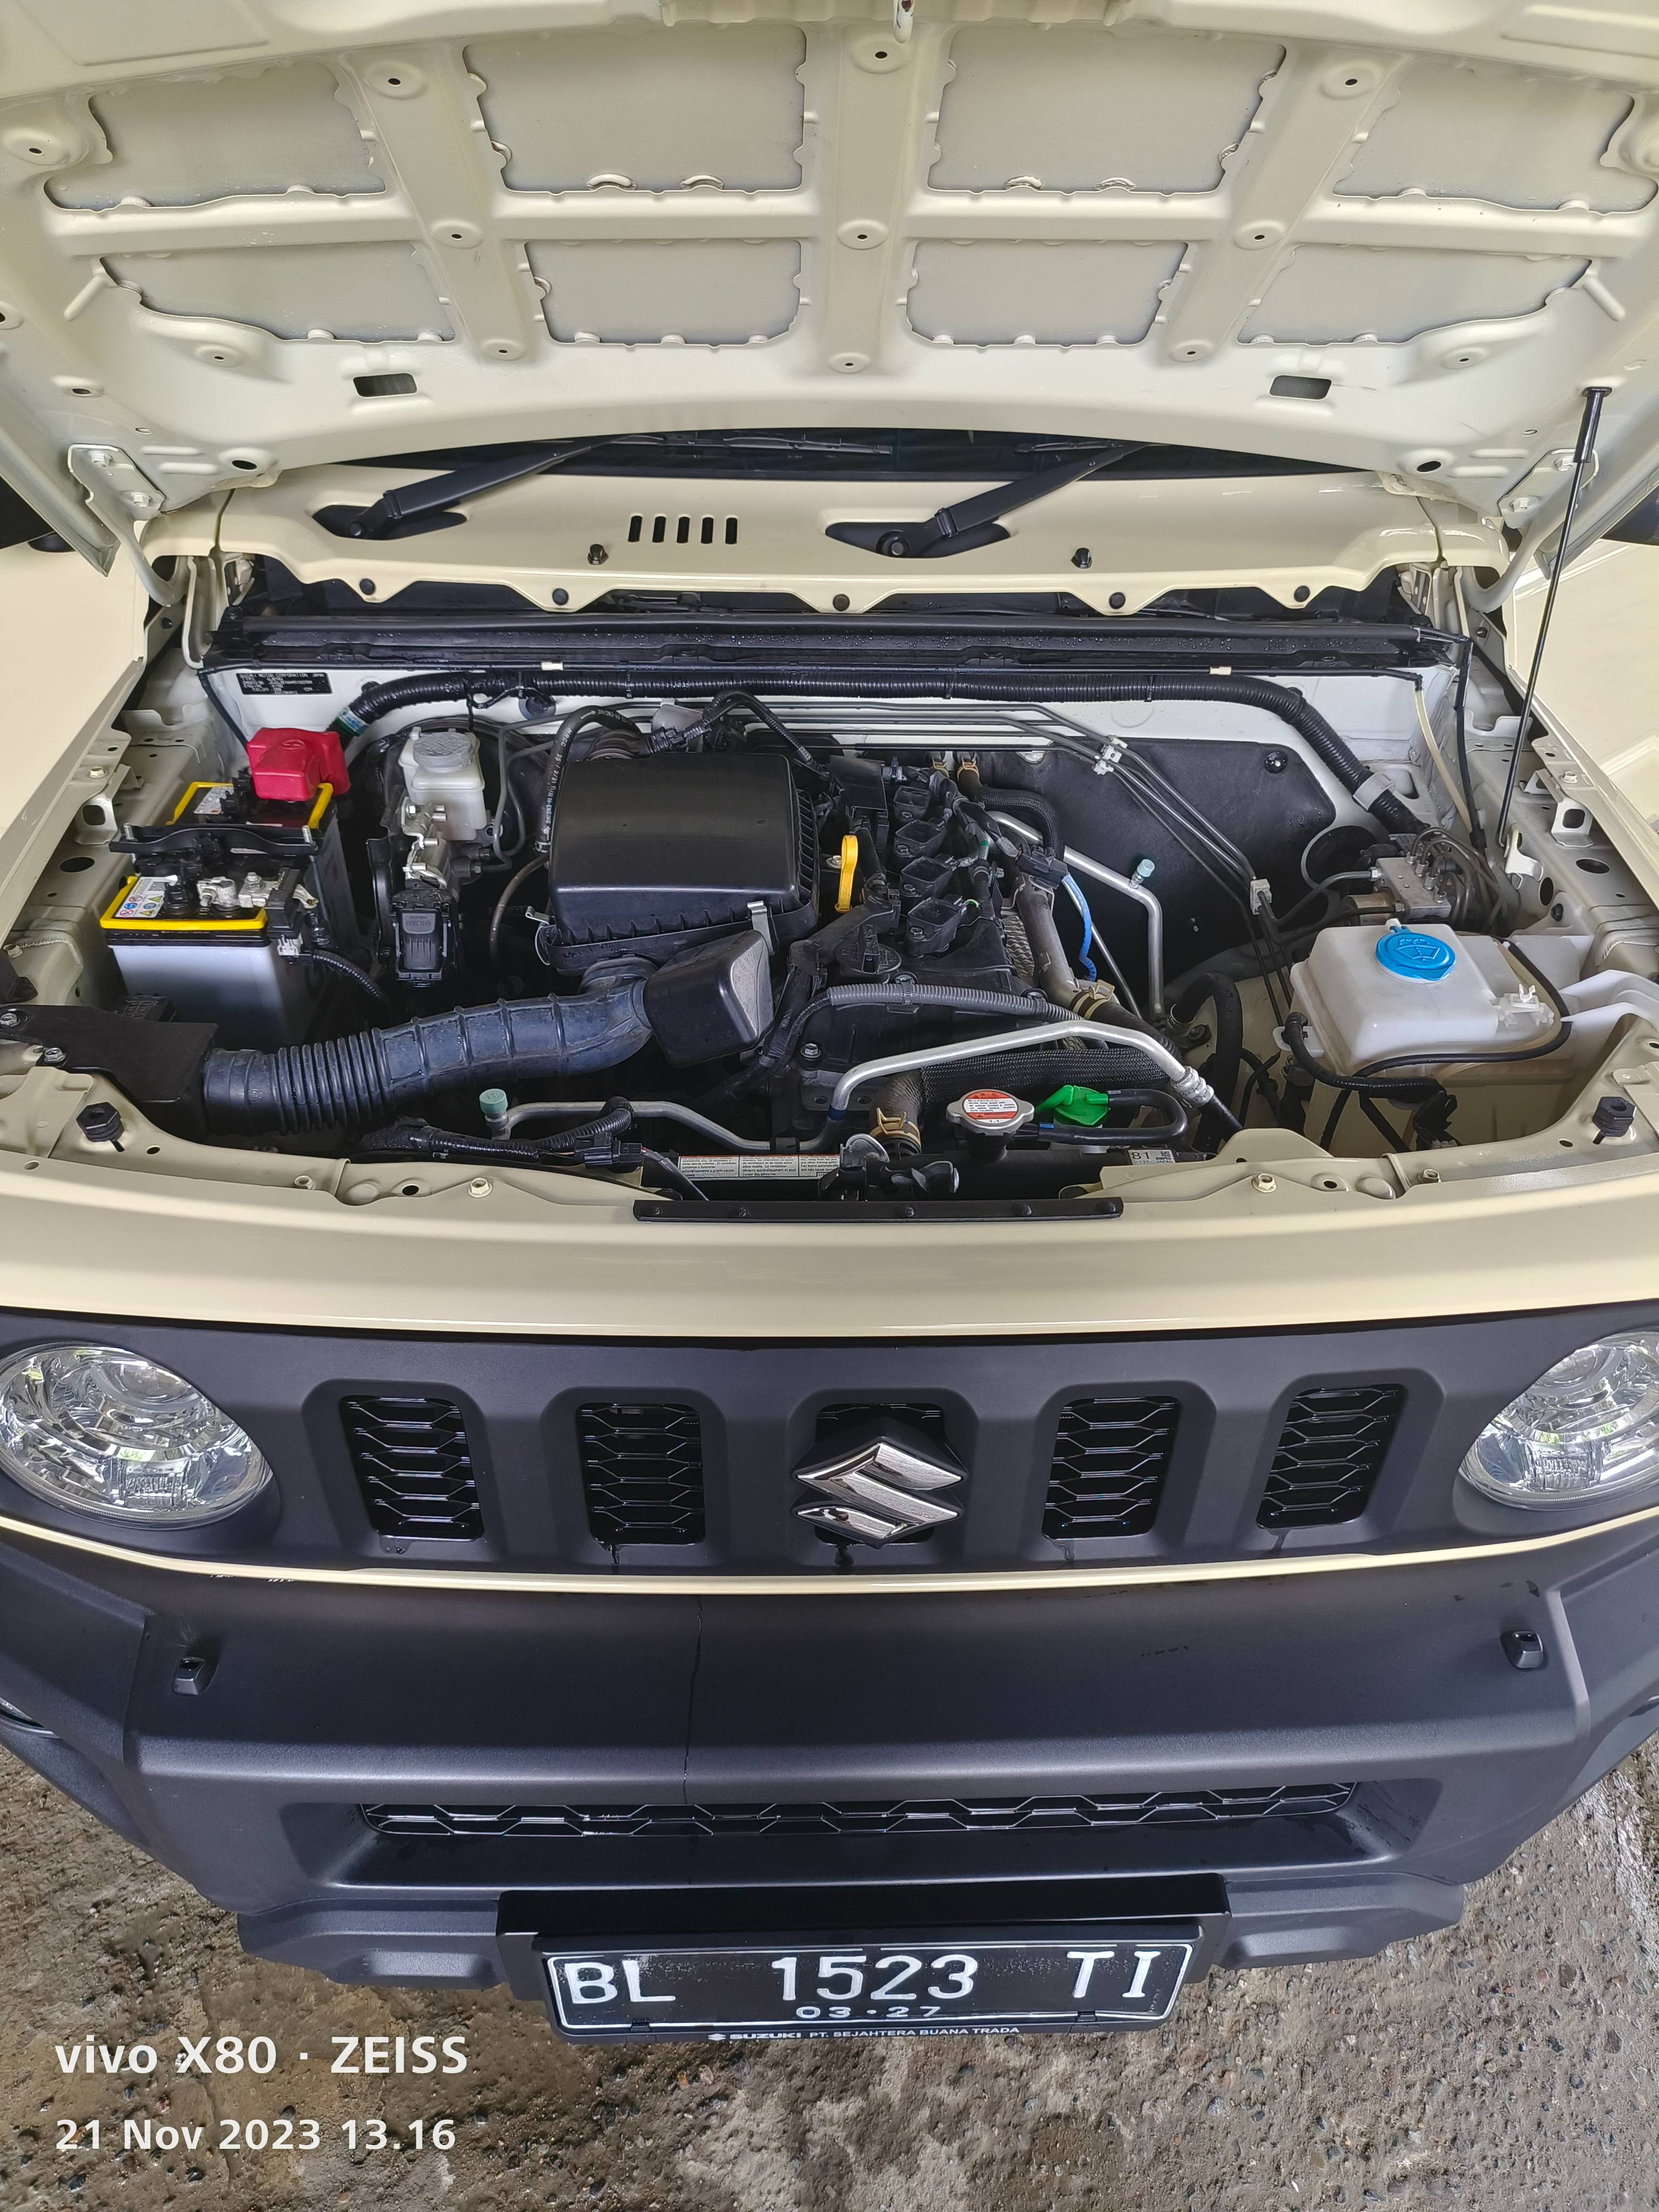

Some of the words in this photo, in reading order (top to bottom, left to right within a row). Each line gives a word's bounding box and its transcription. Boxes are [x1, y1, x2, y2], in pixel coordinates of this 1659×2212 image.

[1131, 1151, 1150, 1160] 81
[564, 1960, 676, 2004] BL
[772, 1954, 978, 2001] 1523
[1067, 1951, 1161, 1998] TI
[833, 2029, 916, 2038] SEJAHTERA
